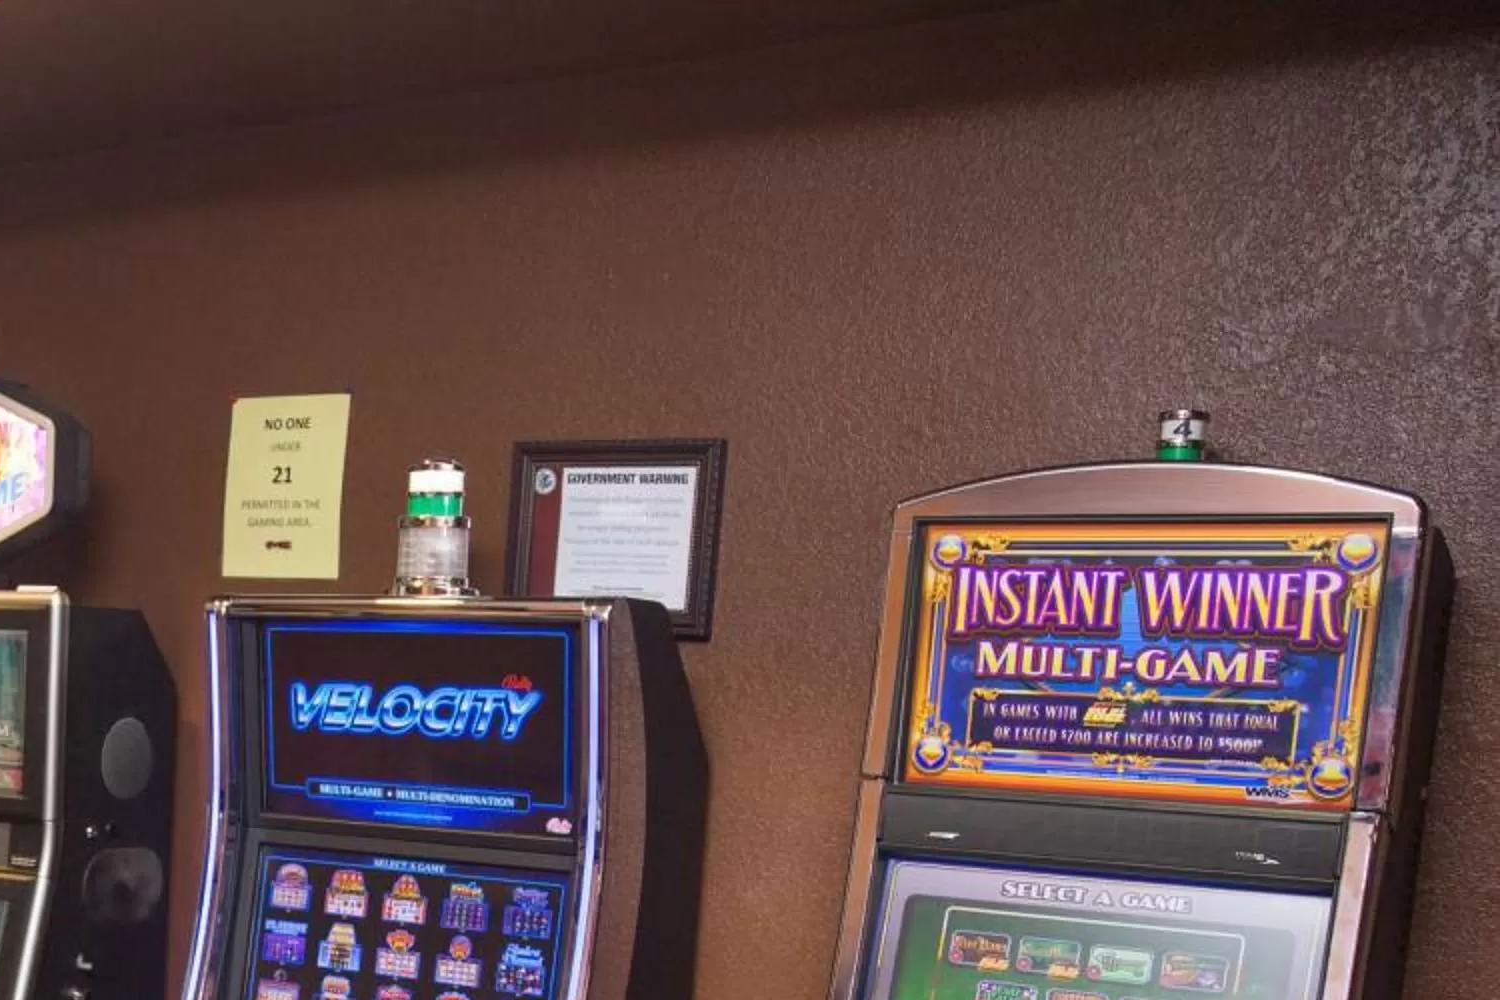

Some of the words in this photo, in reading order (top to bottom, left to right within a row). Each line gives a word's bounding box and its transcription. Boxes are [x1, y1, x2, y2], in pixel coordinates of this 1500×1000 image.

[263, 418, 283, 431] NO
[285, 417, 312, 430] ONE
[272, 466, 293, 484] 21
[567, 472, 635, 485] GOVERNMENT
[639, 473, 689, 485] WARNING
[952, 566, 1126, 634] INSTANT
[1141, 566, 1348, 645] WINNER
[975, 639, 1281, 687] MULTI-GAME
[290, 681, 542, 741] VELOCITY
[983, 702, 995, 717] IN
[1000, 703, 1040, 720] GAMES
[1045, 704, 1078, 721] WITH
[1140, 709, 1163, 726] ALL
[1169, 711, 1204, 728] WINS
[1209, 712, 1242, 729] THAT
[1245, 713, 1279, 732] EQUAL
[993, 726, 1011, 740] OR
[1014, 726, 1057, 744] EXCEED
[1061, 728, 1092, 745] $200
[1095, 731, 1119, 746] ARE
[1123, 731, 1193, 749] INCREASED
[1199, 735, 1213, 751] TO
[1244, 786, 1290, 800] WMS
[1000, 878, 1088, 904] SELECT
[1092, 888, 1116, 907] A
[1120, 891, 1193, 914] GAME
